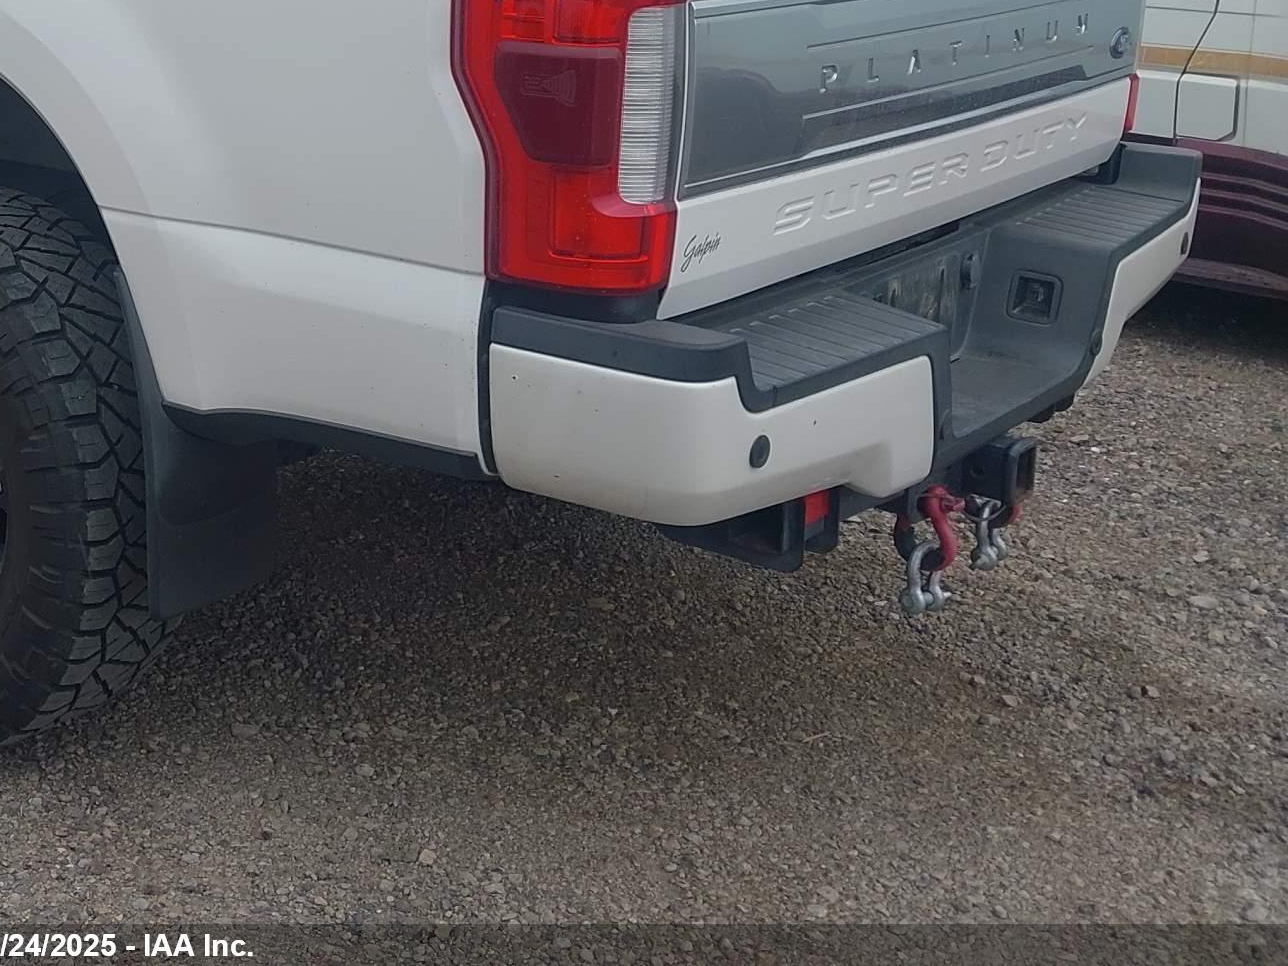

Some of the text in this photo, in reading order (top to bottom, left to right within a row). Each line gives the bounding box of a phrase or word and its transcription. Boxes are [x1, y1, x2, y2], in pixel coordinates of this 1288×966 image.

[818, 12, 1090, 94] PLATINUM
[773, 112, 1088, 236] SUPER DUTY
